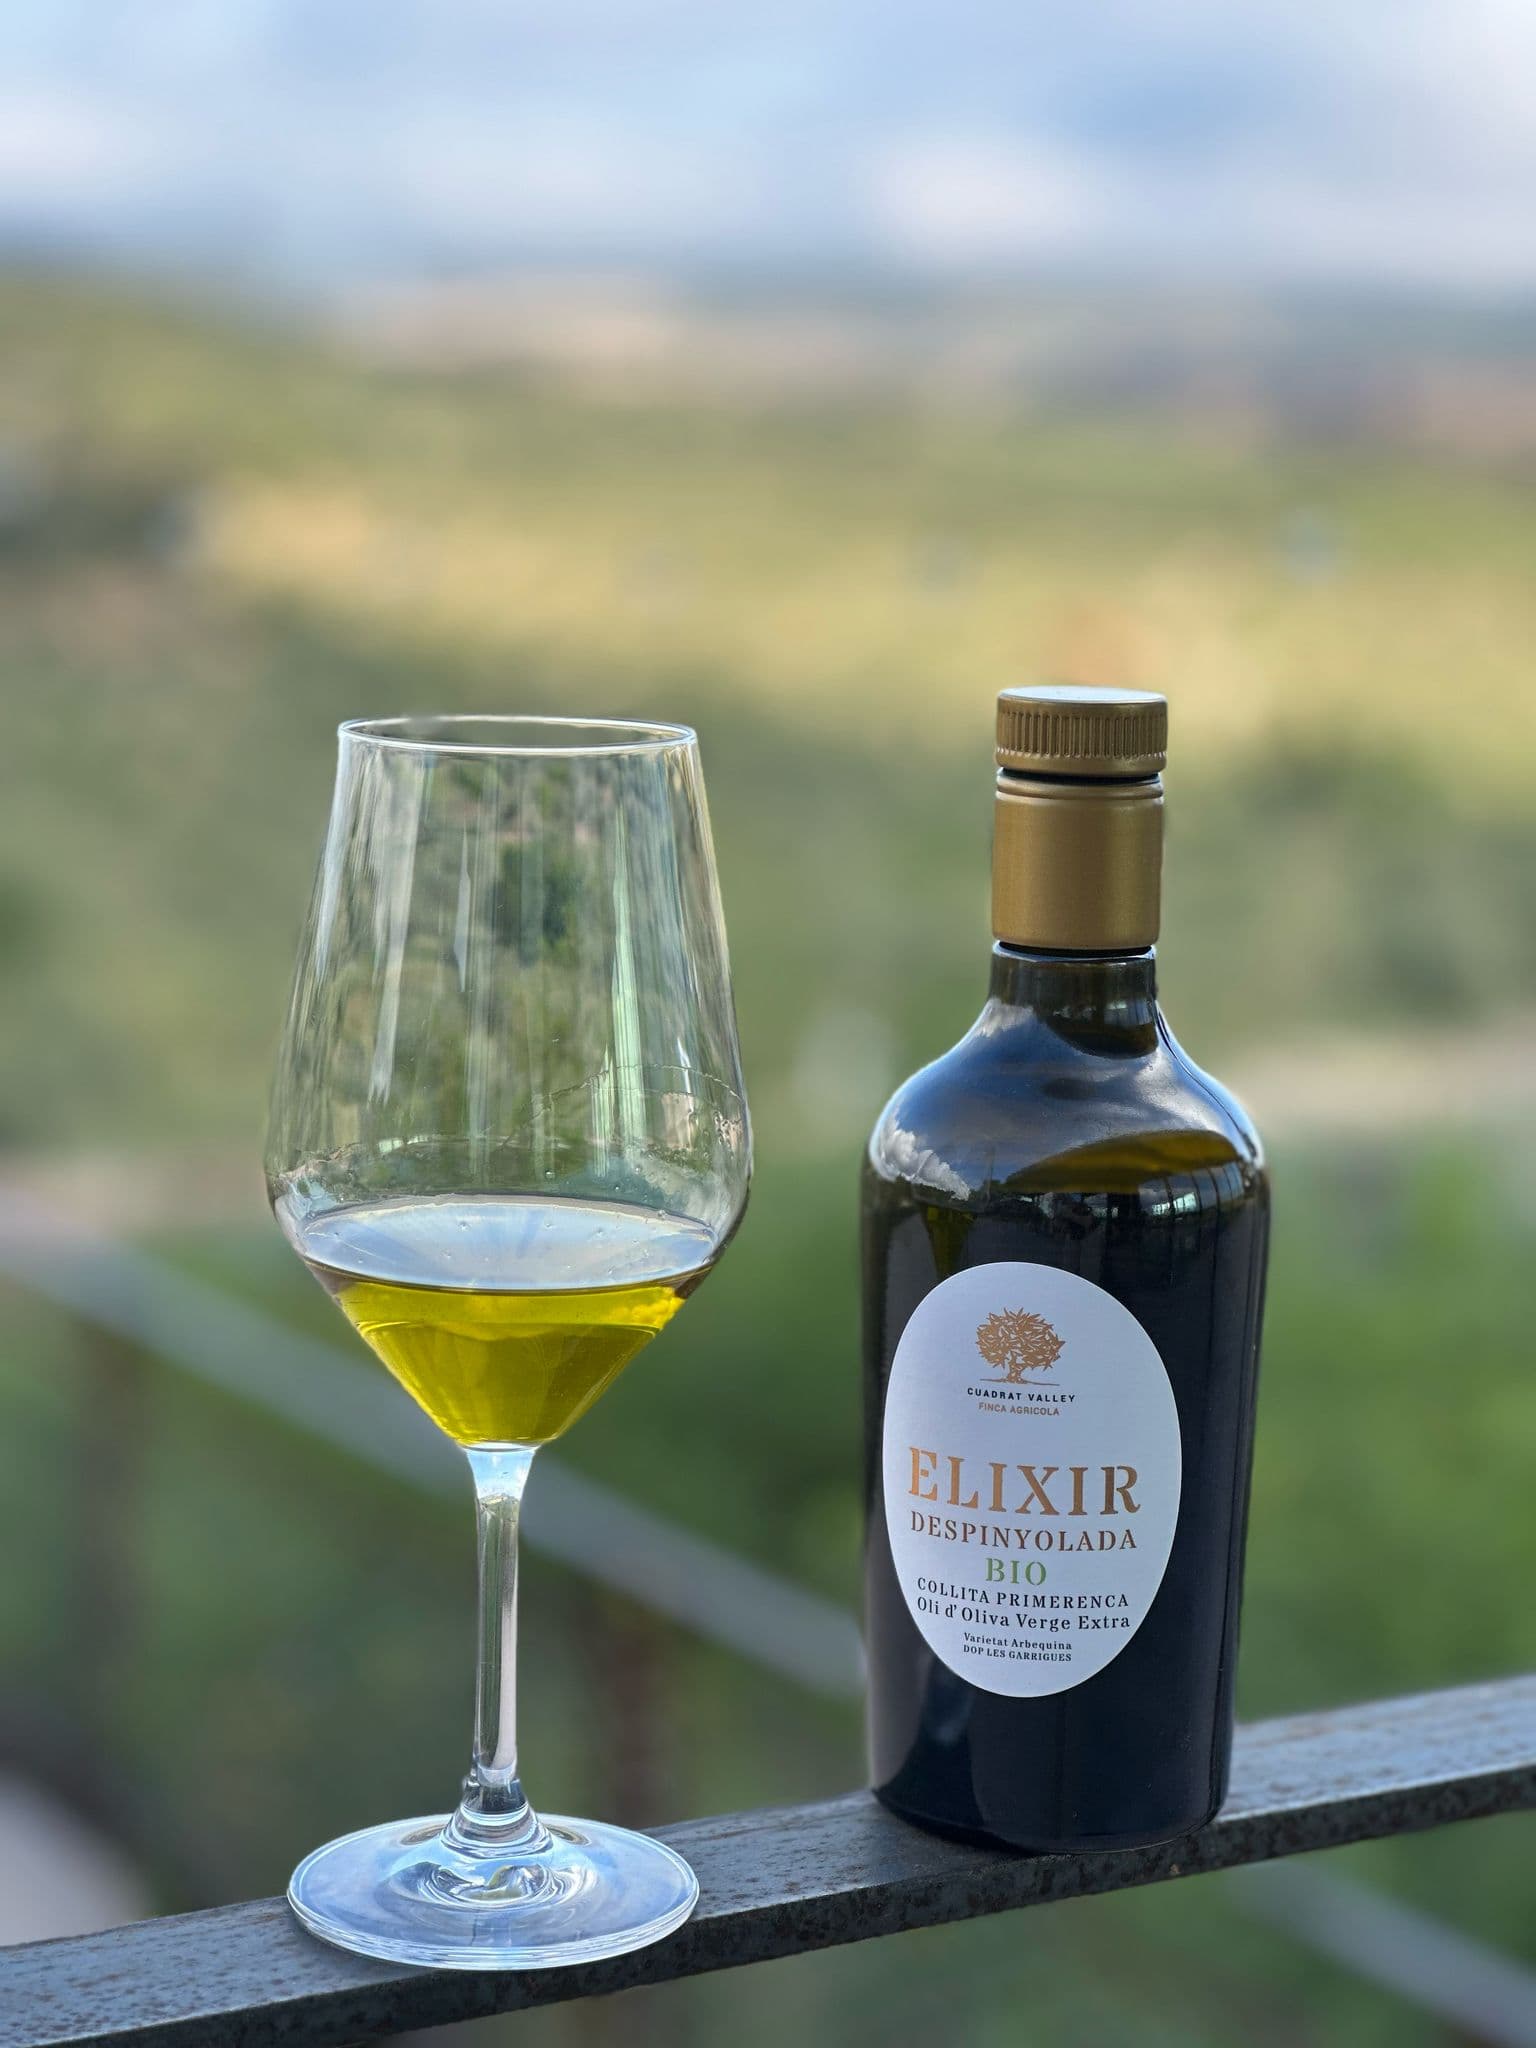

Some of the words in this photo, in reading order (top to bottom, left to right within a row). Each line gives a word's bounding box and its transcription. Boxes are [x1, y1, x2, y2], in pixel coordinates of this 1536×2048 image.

[967, 1387, 1022, 1401] CUADRAT
[1028, 1393, 1076, 1402] VALLEY
[979, 1402, 1007, 1412] FINCA
[1010, 1406, 1060, 1416] AGRICOLA
[908, 1447, 1141, 1516] ELIXIR
[911, 1510, 1137, 1551] DESPINYOLADA
[985, 1557, 1047, 1586] BIO
[917, 1577, 990, 1604] COLLITA
[996, 1592, 1129, 1609] PRIMERENCA
[917, 1596, 939, 1615] Oli
[1016, 1613, 1071, 1633] Verge
[1078, 1615, 1130, 1630] Extra
[963, 1644, 984, 1655] DOP
[986, 1648, 1006, 1658] LES
[1008, 1651, 1072, 1662] GARRIGUES
[964, 1632, 1009, 1647] Varietat
[1011, 1638, 1072, 1652] Arbequina
